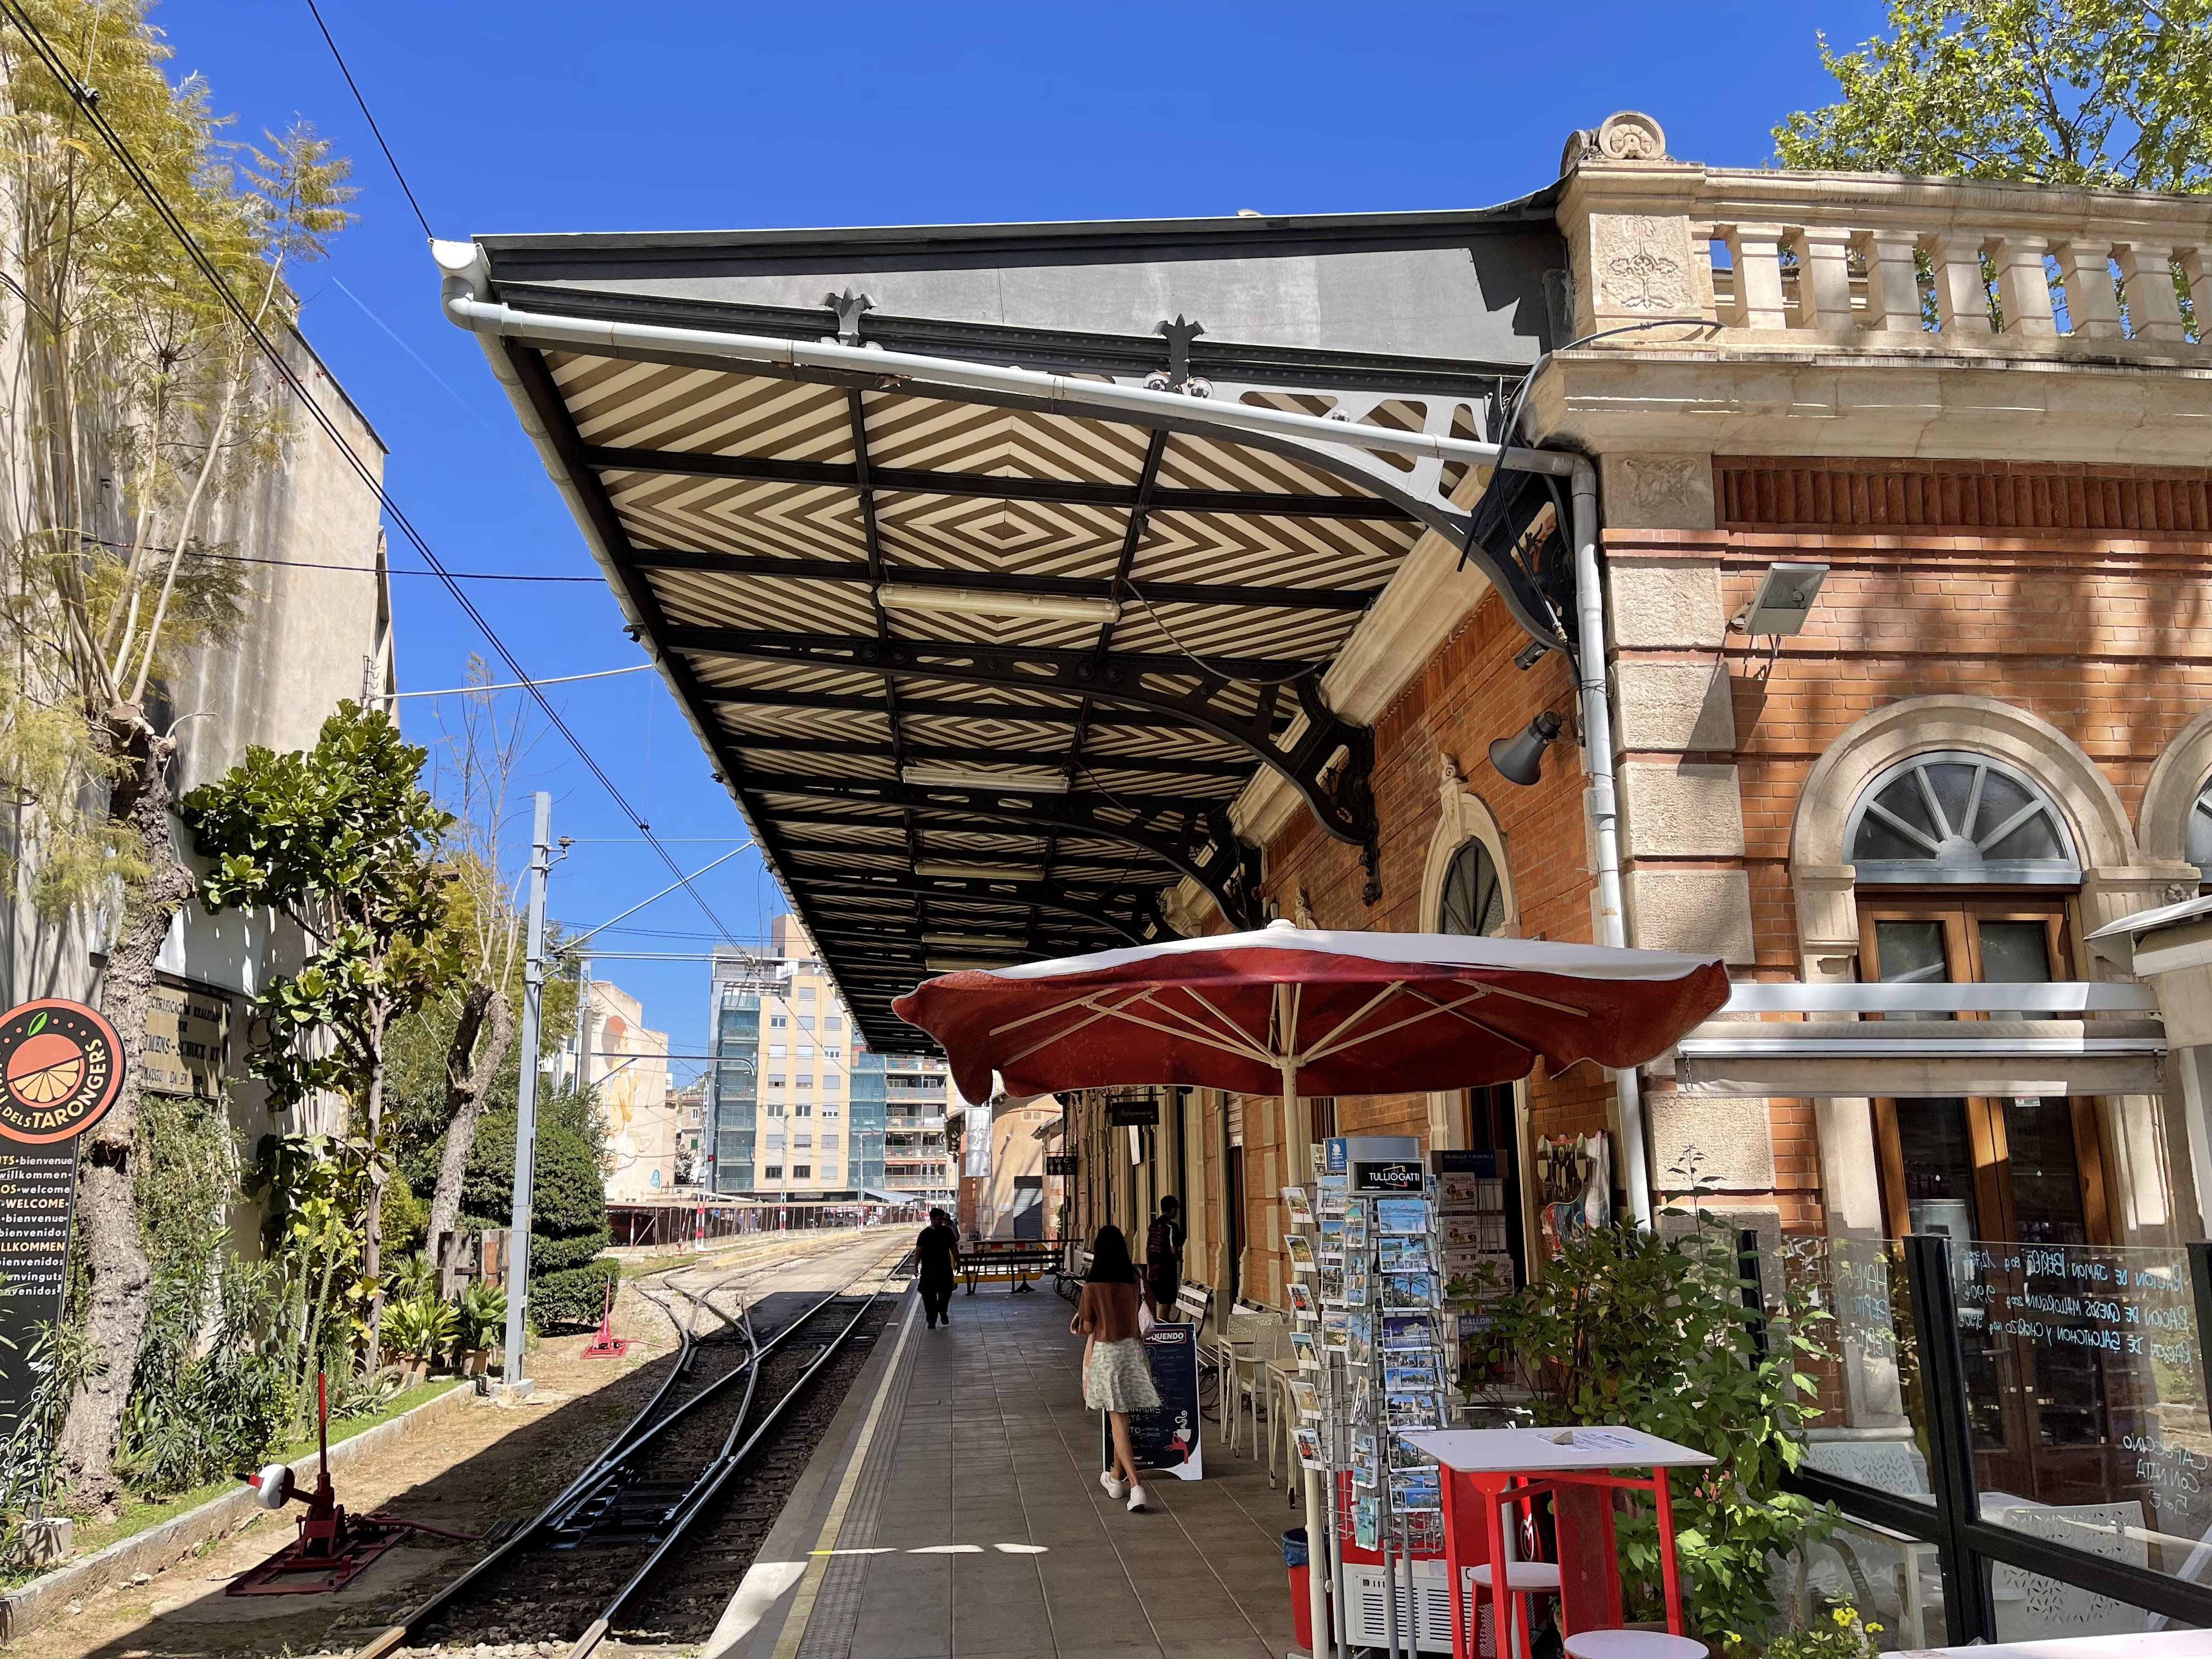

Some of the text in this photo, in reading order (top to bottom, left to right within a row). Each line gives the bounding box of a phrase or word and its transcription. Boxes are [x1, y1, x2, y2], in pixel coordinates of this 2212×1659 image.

[2, 1105, 32, 1128] DELS
[32, 1039, 106, 1128] TARONGERS
[0, 1155, 73, 1165] TS bienvenue
[21, 1185, 71, 1193] welcome
[5, 1199, 65, 1209] WELCOME
[5, 1214, 64, 1223] bienvenue
[0, 1242, 65, 1251] LLKOMMEN
[0, 1257, 64, 1266] ienvenidos
